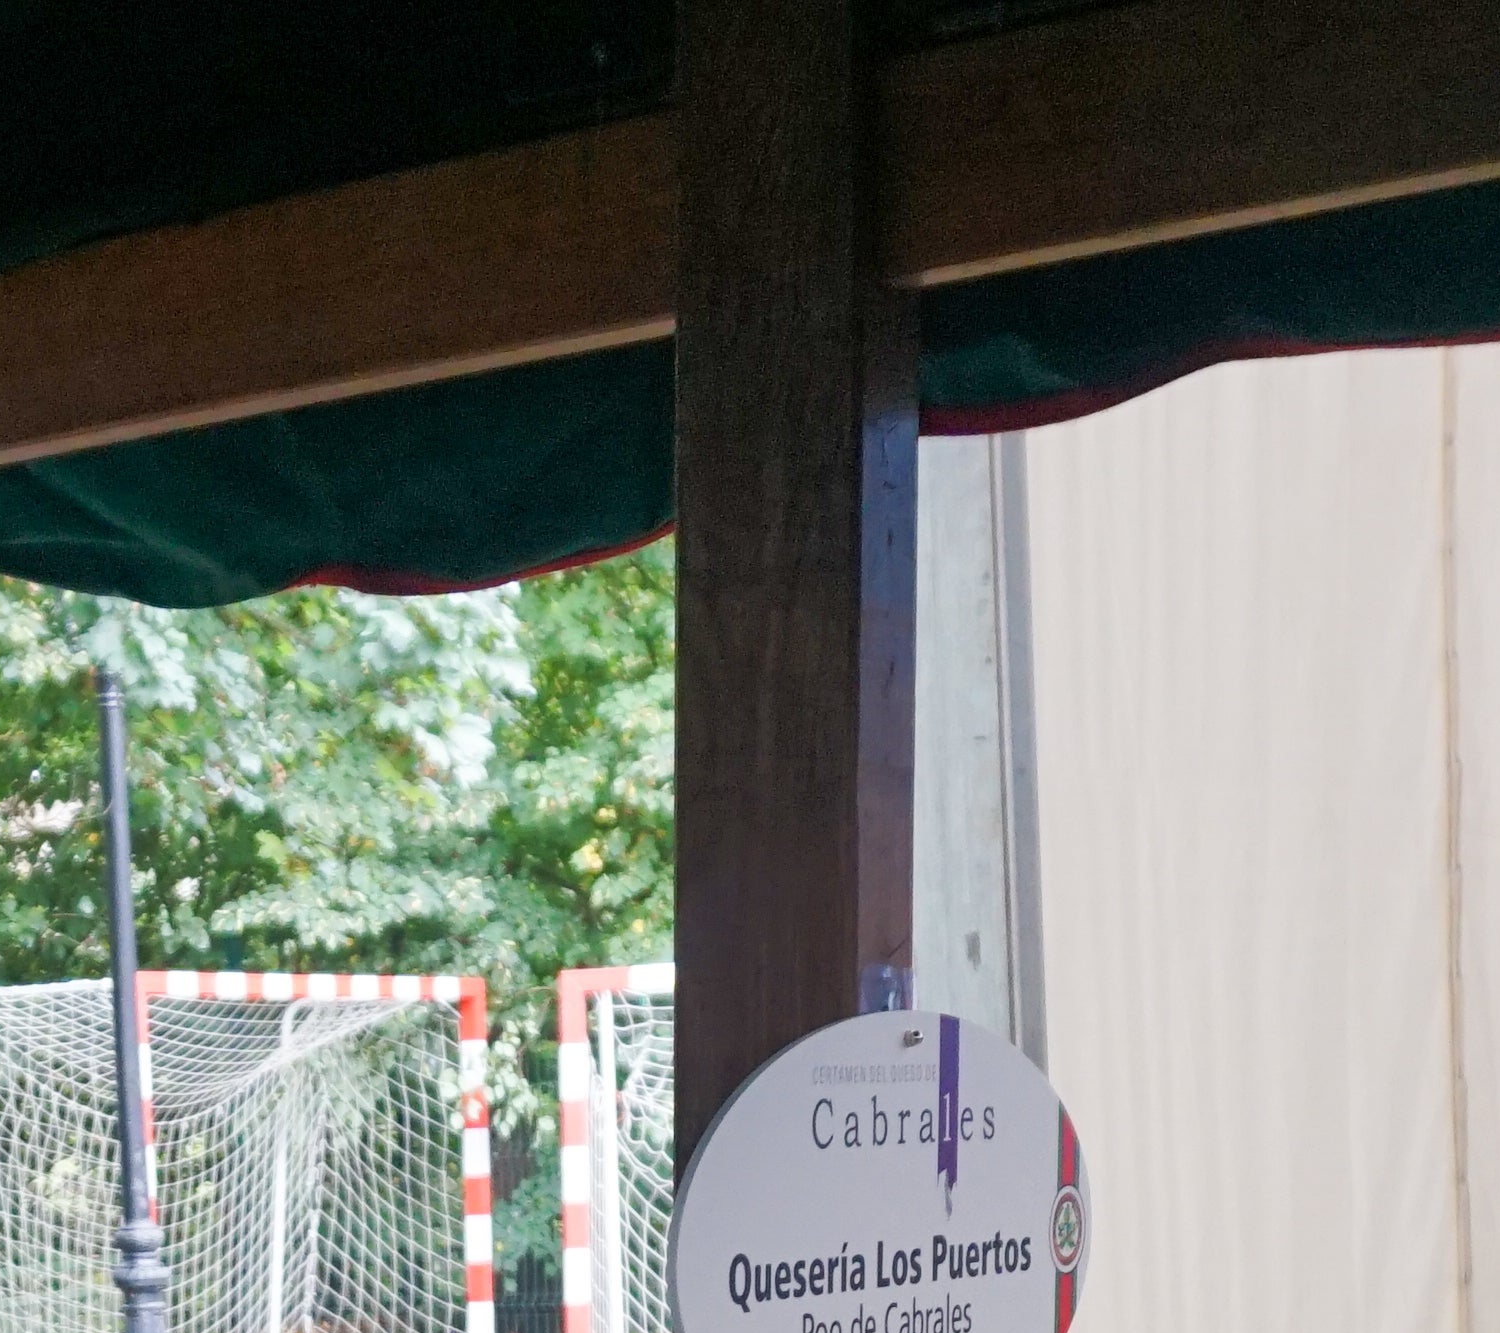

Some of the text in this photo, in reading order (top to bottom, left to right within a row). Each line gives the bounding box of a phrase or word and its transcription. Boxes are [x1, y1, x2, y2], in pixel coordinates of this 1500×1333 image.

[812, 1092, 996, 1149] Cabrales
[728, 1230, 1032, 1313] Quesería Los Puertos
